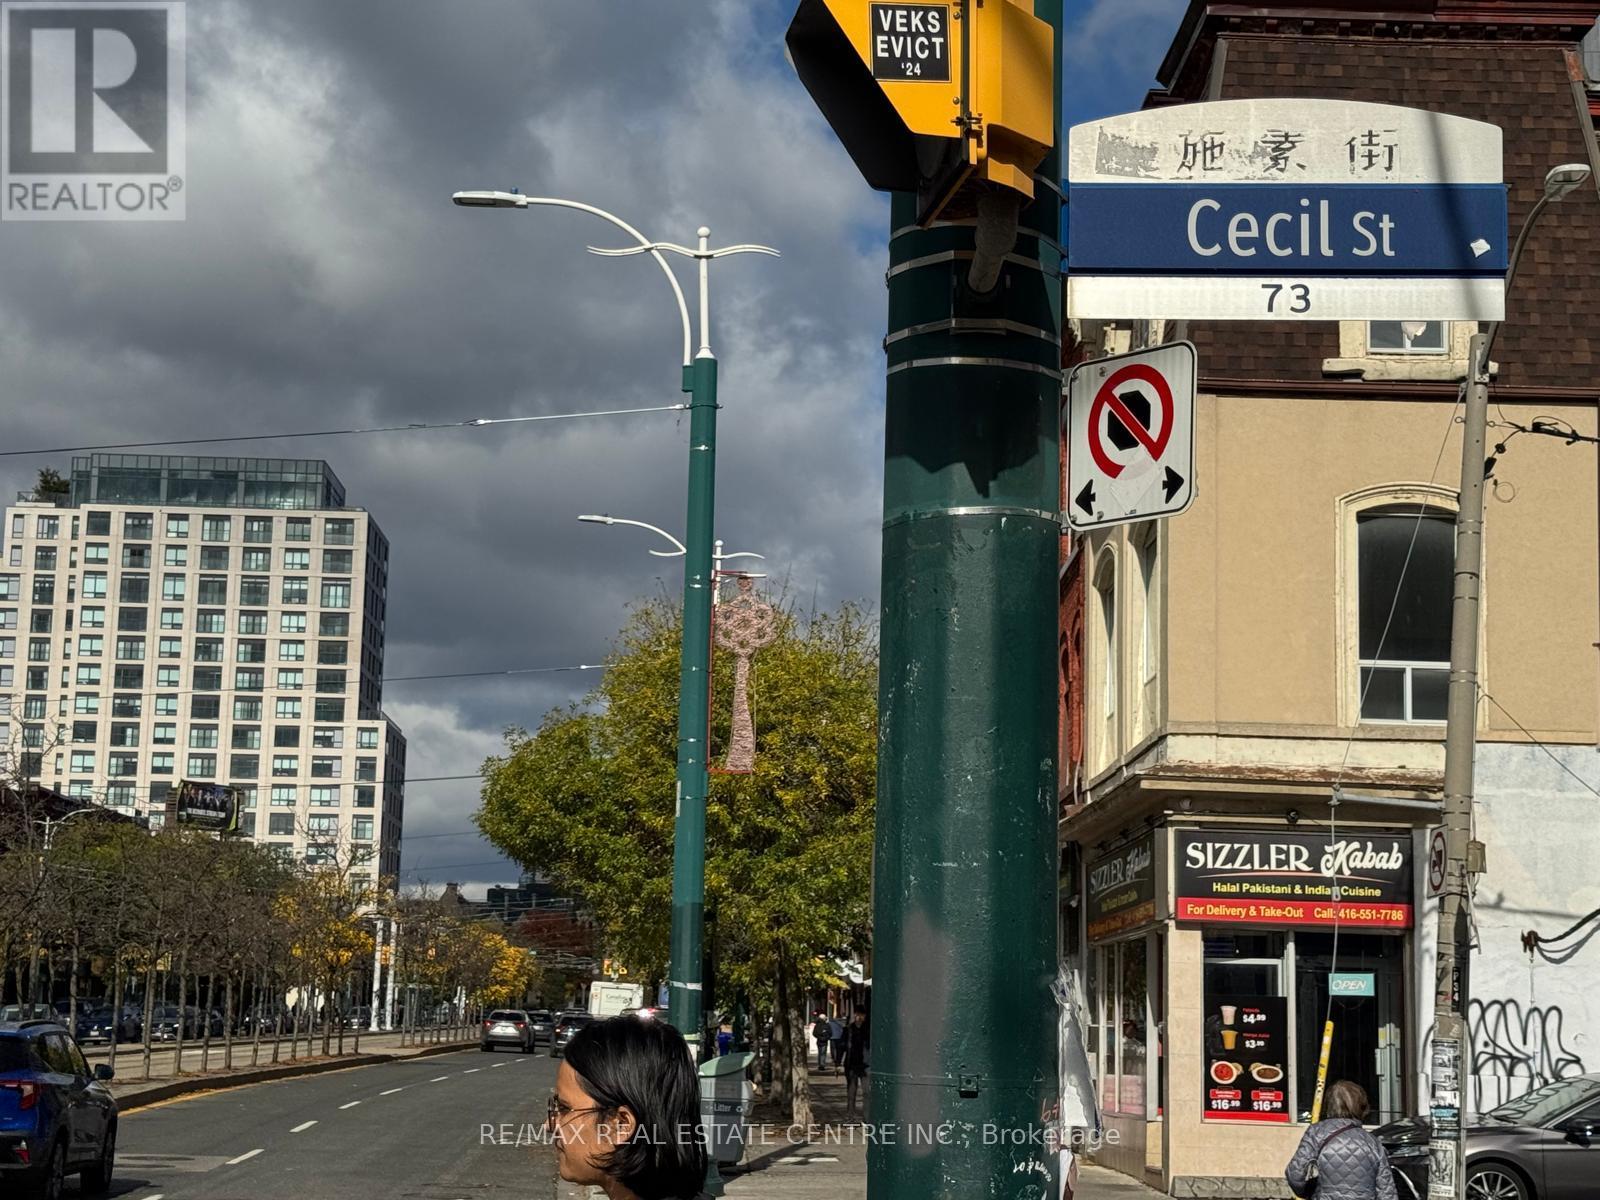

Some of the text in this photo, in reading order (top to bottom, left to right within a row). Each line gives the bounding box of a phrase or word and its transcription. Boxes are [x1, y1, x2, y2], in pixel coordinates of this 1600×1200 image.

[879, 9, 941, 33] VEKS
[876, 35, 944, 59] EVICT
[1187, 199, 1396, 257] Cecil St
[1261, 284, 1311, 313] 73
[1185, 840, 1404, 878] SIZZLER Kabab
[1212, 882, 1382, 898] Halal Pakistani & India Cuisine
[1187, 904, 1203, 915] For
[1206, 905, 1246, 919] Delivery
[1249, 906, 1257, 916] &
[1260, 906, 1304, 918] Take-Out
[1338, 909, 1404, 921] 416-551-7786
[1332, 979, 1366, 991] OPEN
[714, 1103, 731, 1112] Litter
